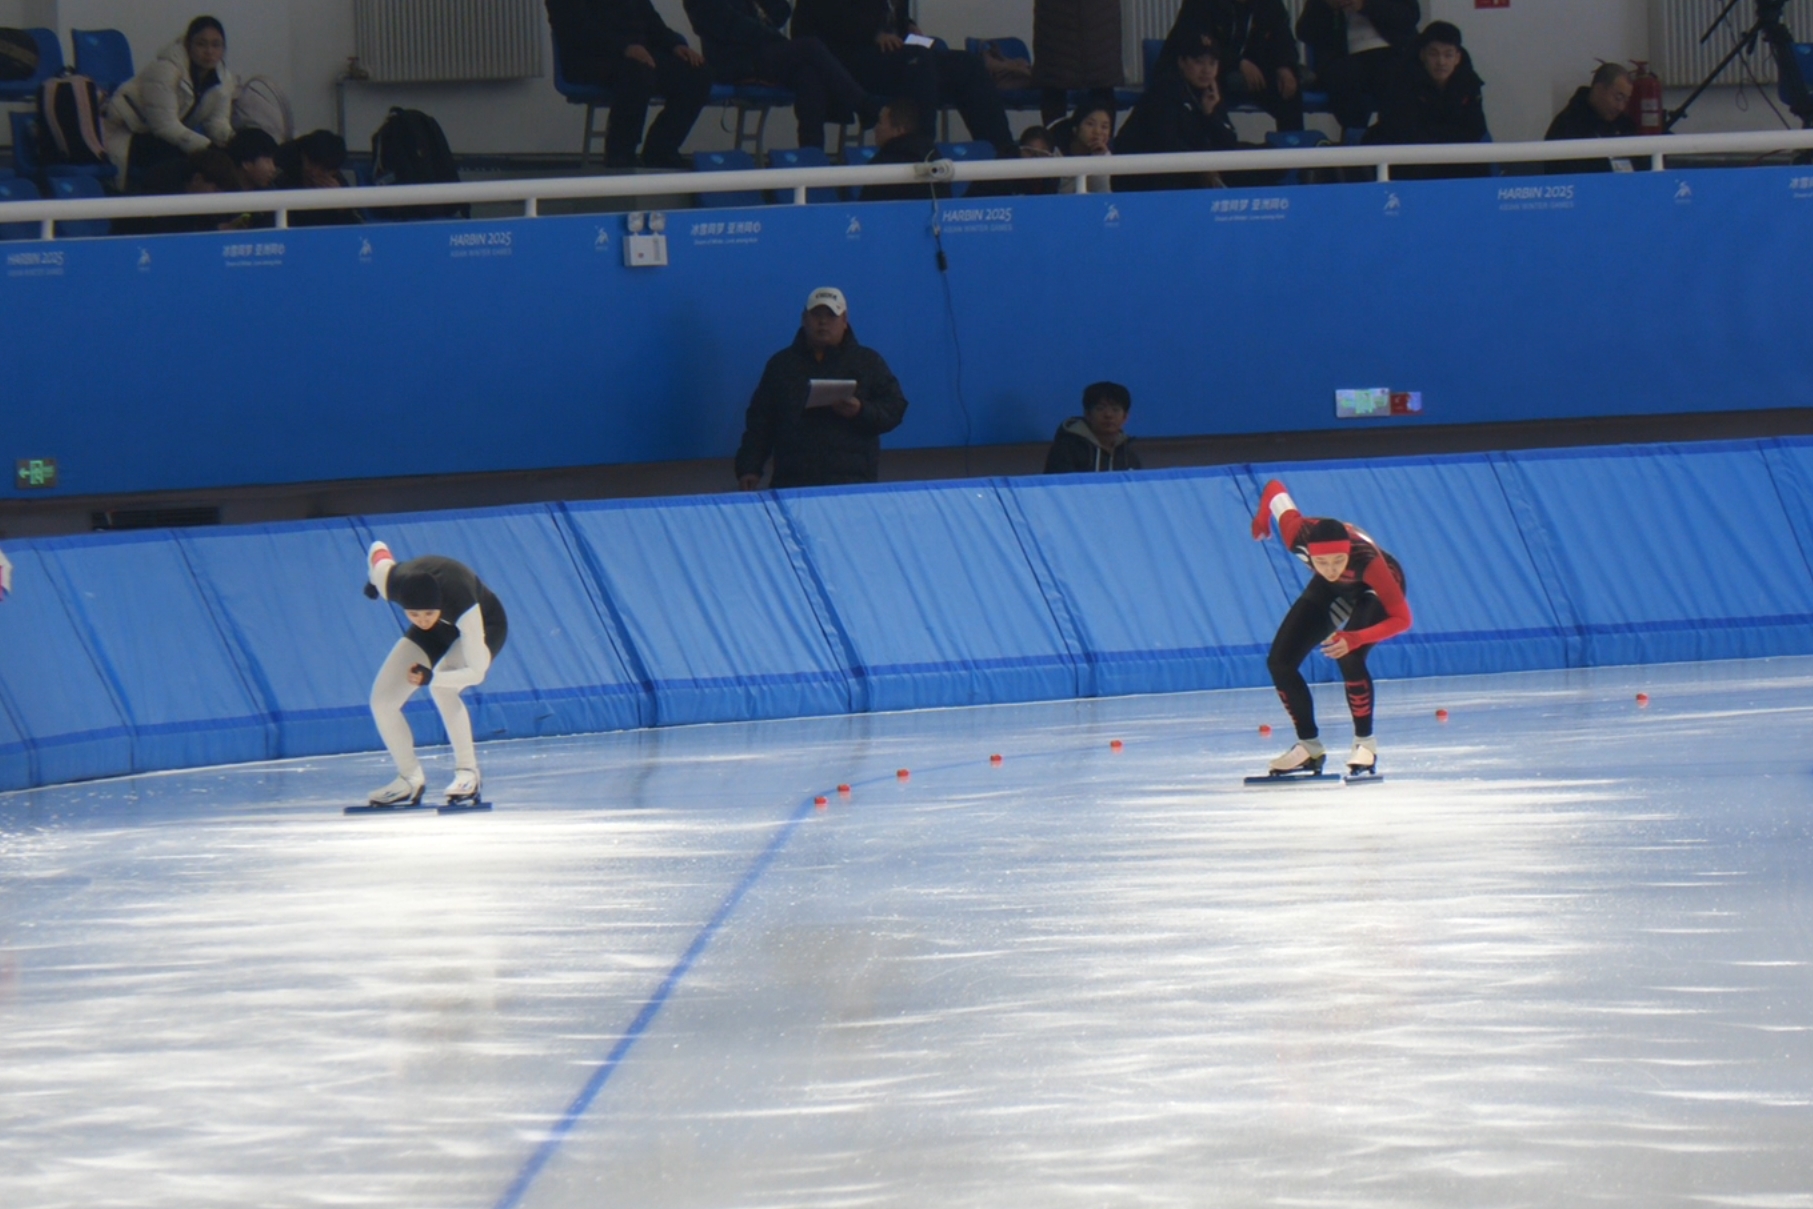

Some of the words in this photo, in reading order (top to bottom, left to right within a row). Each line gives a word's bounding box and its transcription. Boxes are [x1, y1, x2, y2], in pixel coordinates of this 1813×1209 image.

[1497, 186, 1542, 200] HARBIN
[1544, 185, 1574, 199] 2025
[942, 208, 983, 222] HARBIN
[985, 207, 1012, 222] 2025
[449, 233, 487, 247] HARBIN
[488, 231, 512, 246] 2025
[41, 251, 64, 265] 2025
